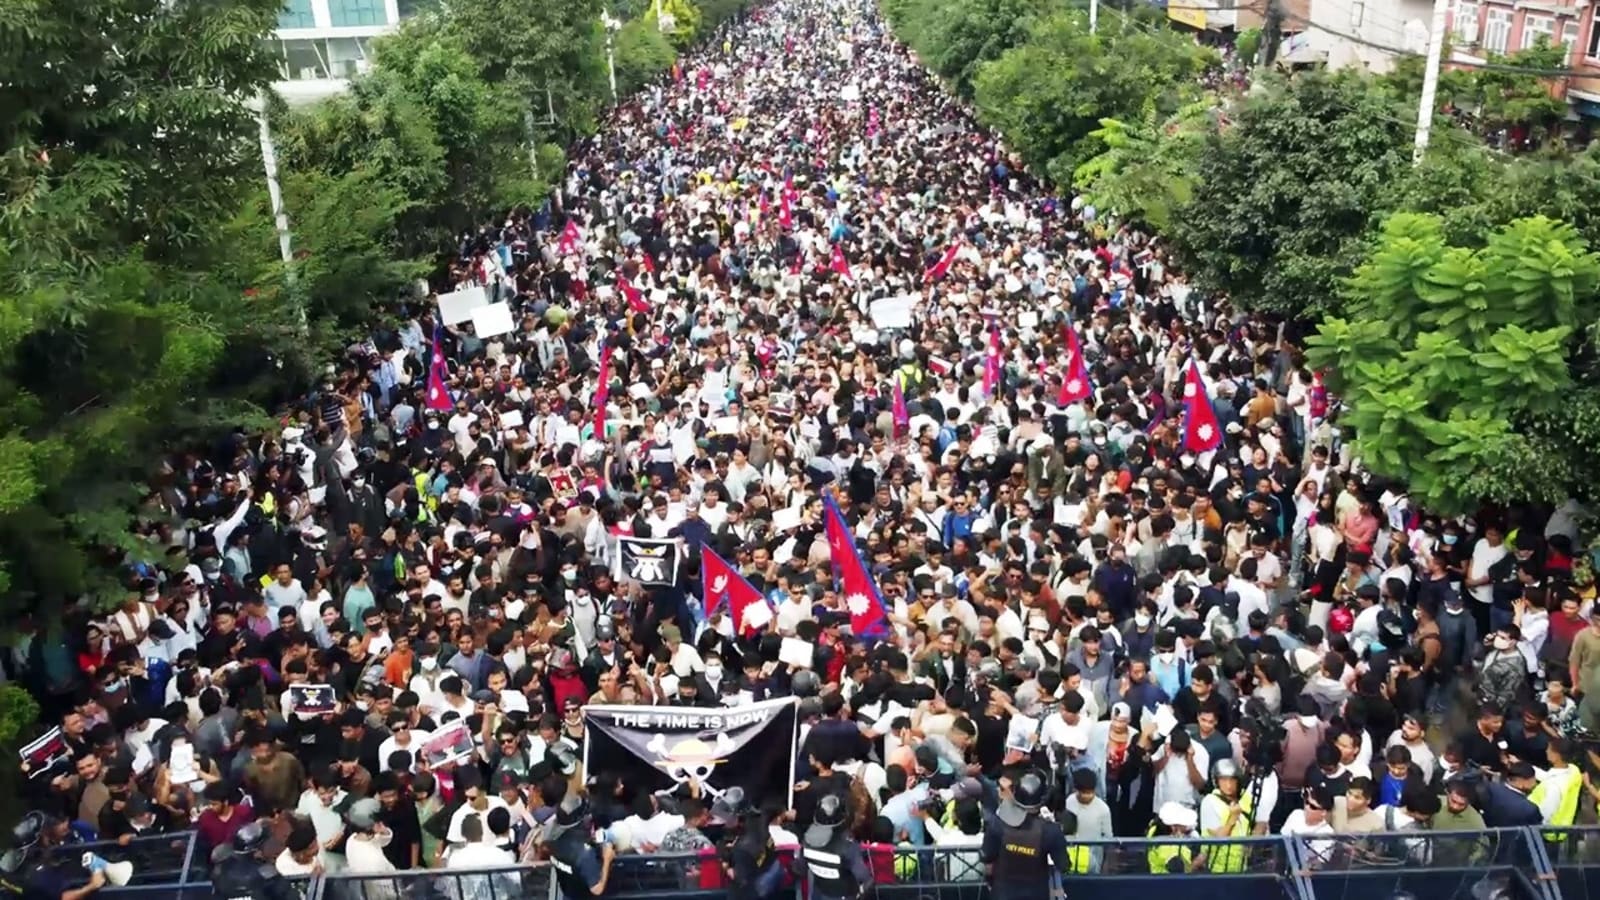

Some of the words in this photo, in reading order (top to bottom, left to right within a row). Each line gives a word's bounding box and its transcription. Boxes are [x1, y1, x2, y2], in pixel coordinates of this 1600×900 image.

[611, 713, 650, 728] THE
[657, 713, 700, 729] TIME
[705, 714, 722, 729] IS
[726, 709, 770, 729] NOW
